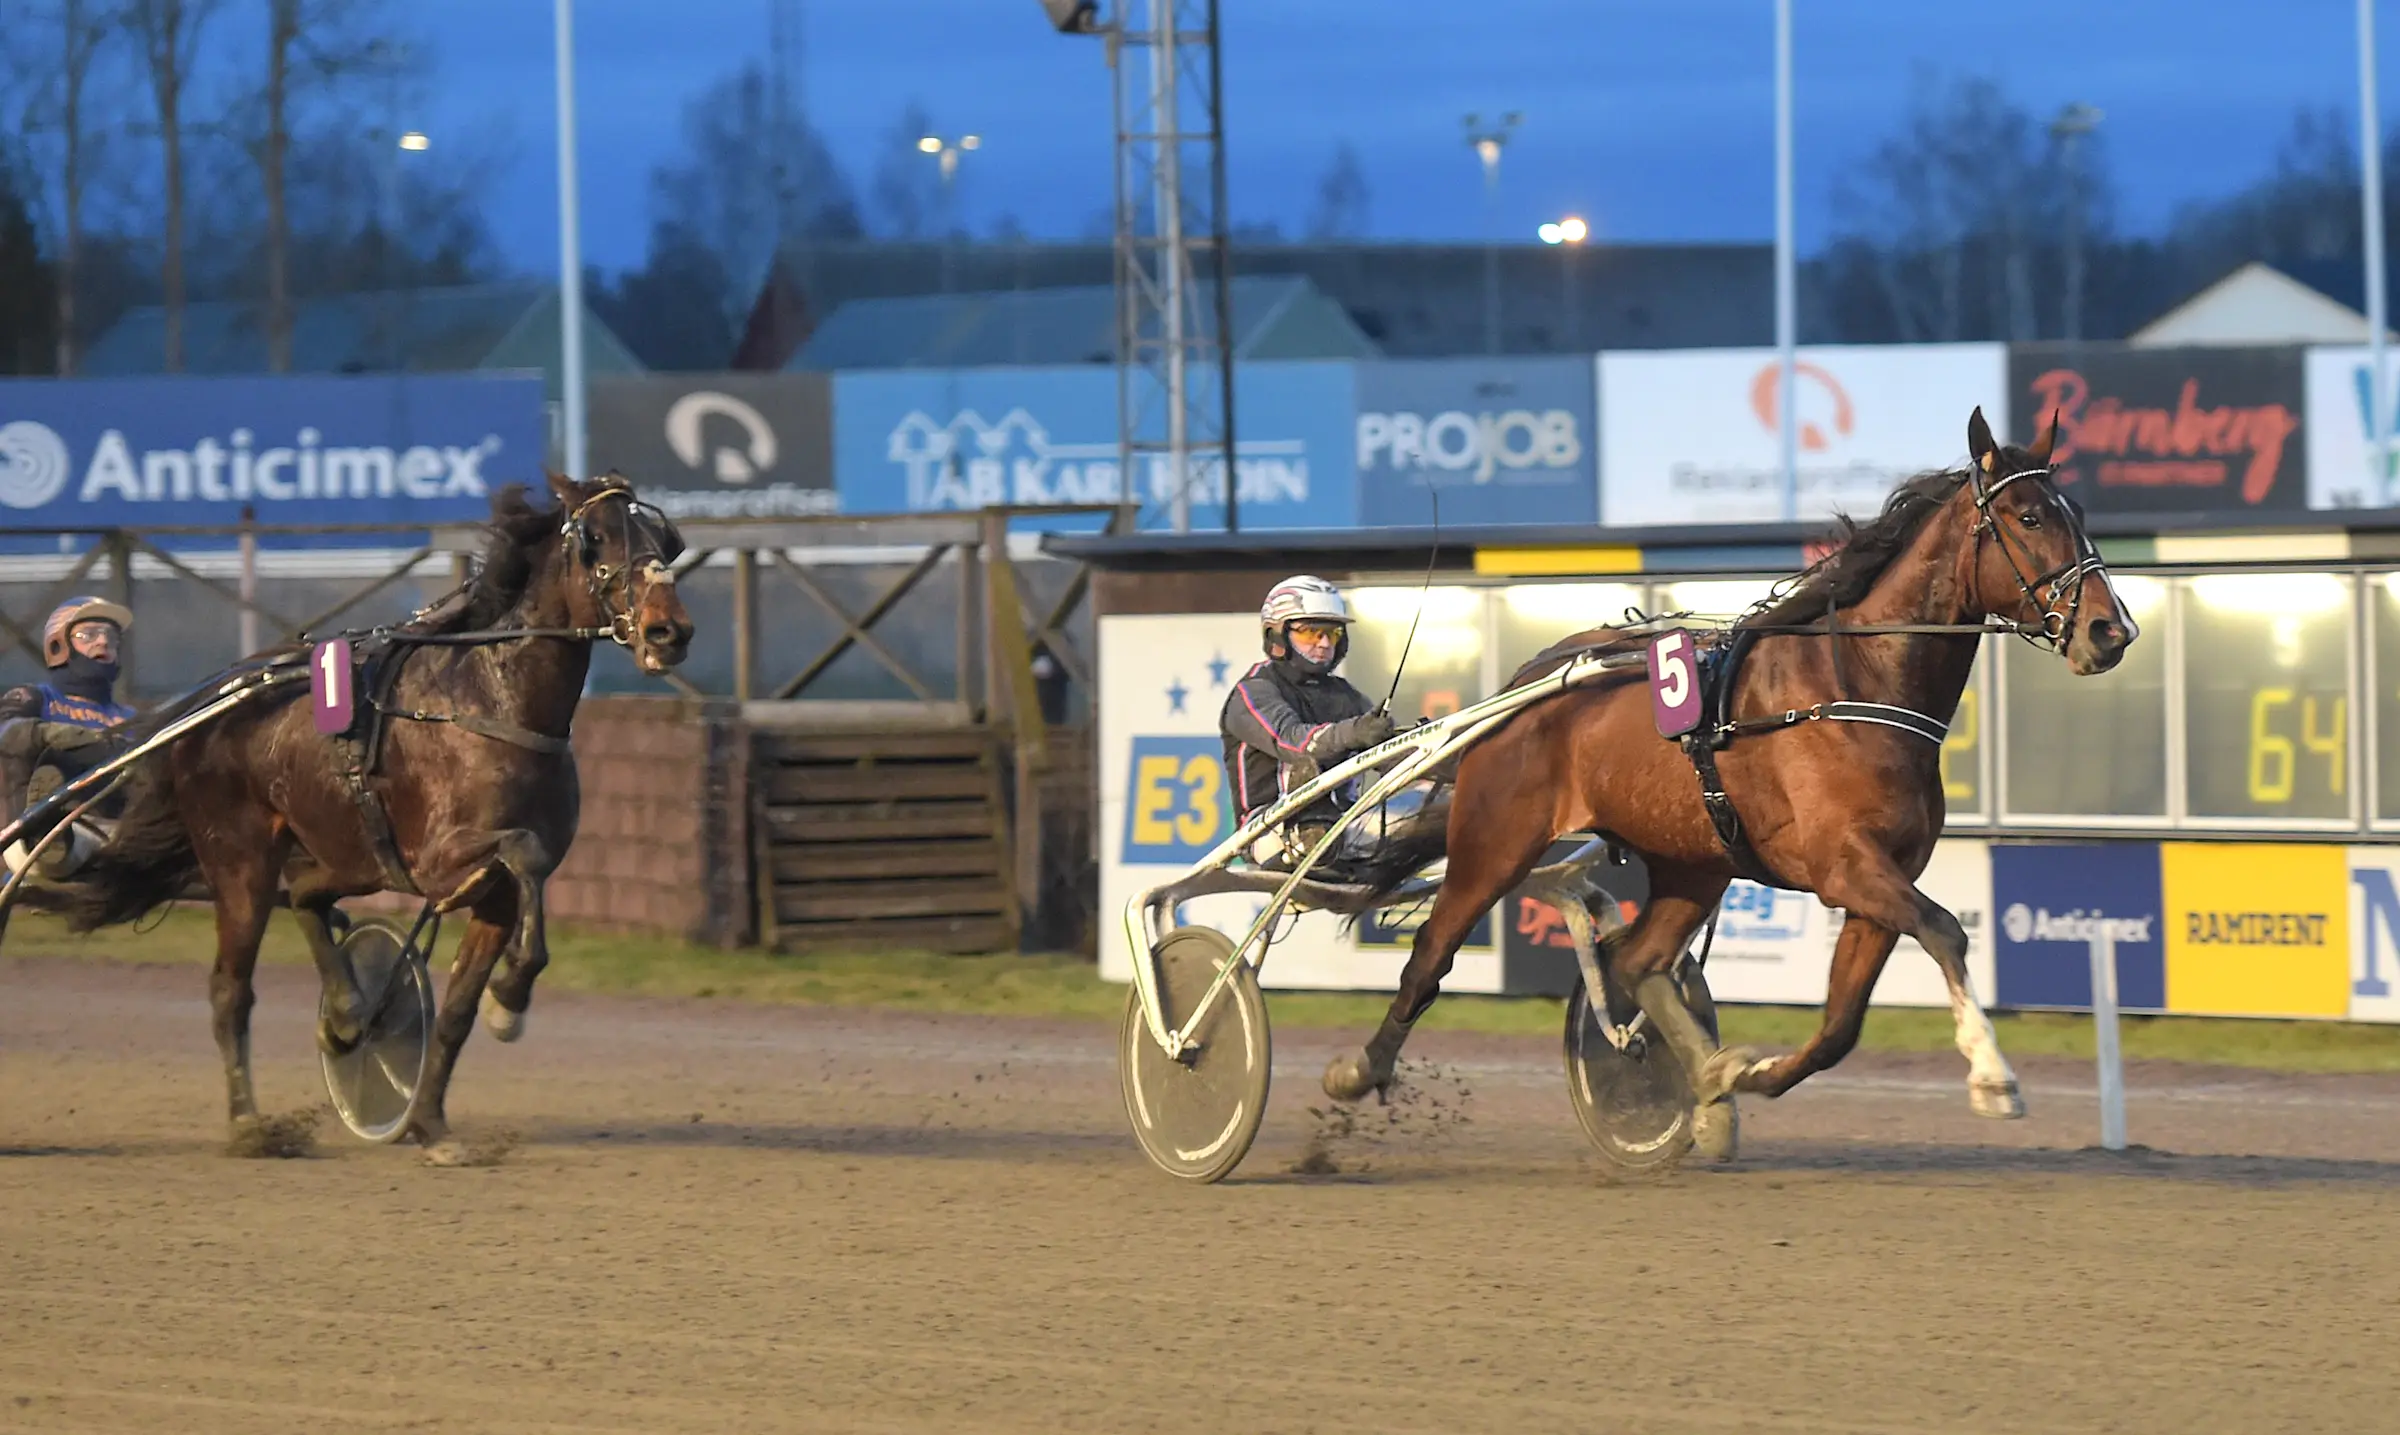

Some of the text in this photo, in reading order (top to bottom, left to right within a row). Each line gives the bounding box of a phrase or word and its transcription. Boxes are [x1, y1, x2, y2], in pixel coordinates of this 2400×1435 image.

[79, 427, 488, 501] Anticimex
[319, 641, 339, 709] 1
[1657, 633, 1689, 708] 5
[1132, 754, 1220, 846] E3
[2186, 912, 2328, 945] RAMIRENT
